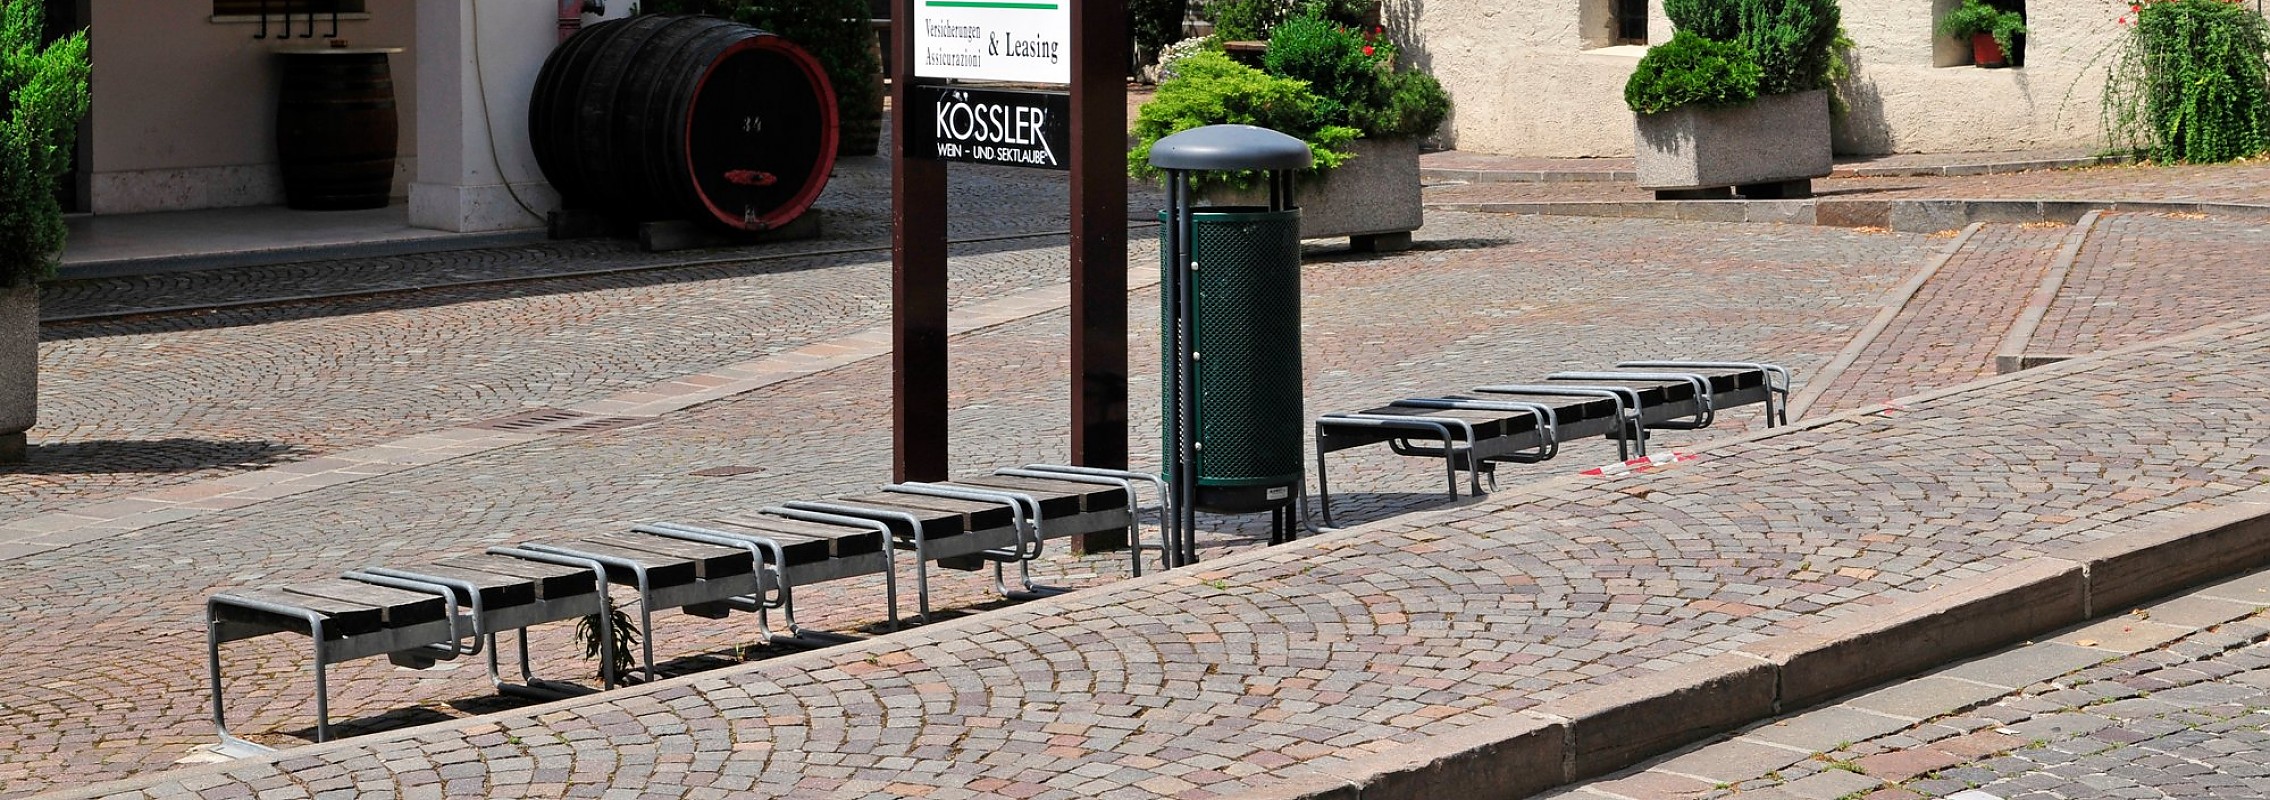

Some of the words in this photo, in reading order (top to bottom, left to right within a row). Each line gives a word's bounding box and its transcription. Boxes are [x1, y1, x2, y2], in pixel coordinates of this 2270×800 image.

[925, 18, 981, 43] Versicherungen
[925, 47, 981, 68] Assicurazioni
[988, 31, 999, 56] &
[1005, 32, 1058, 64] Leasing
[936, 91, 1057, 165] KÖSSLER
[937, 142, 962, 158] WEIN
[973, 145, 994, 160] UND
[996, 147, 1046, 165] SEKTLAUBE
